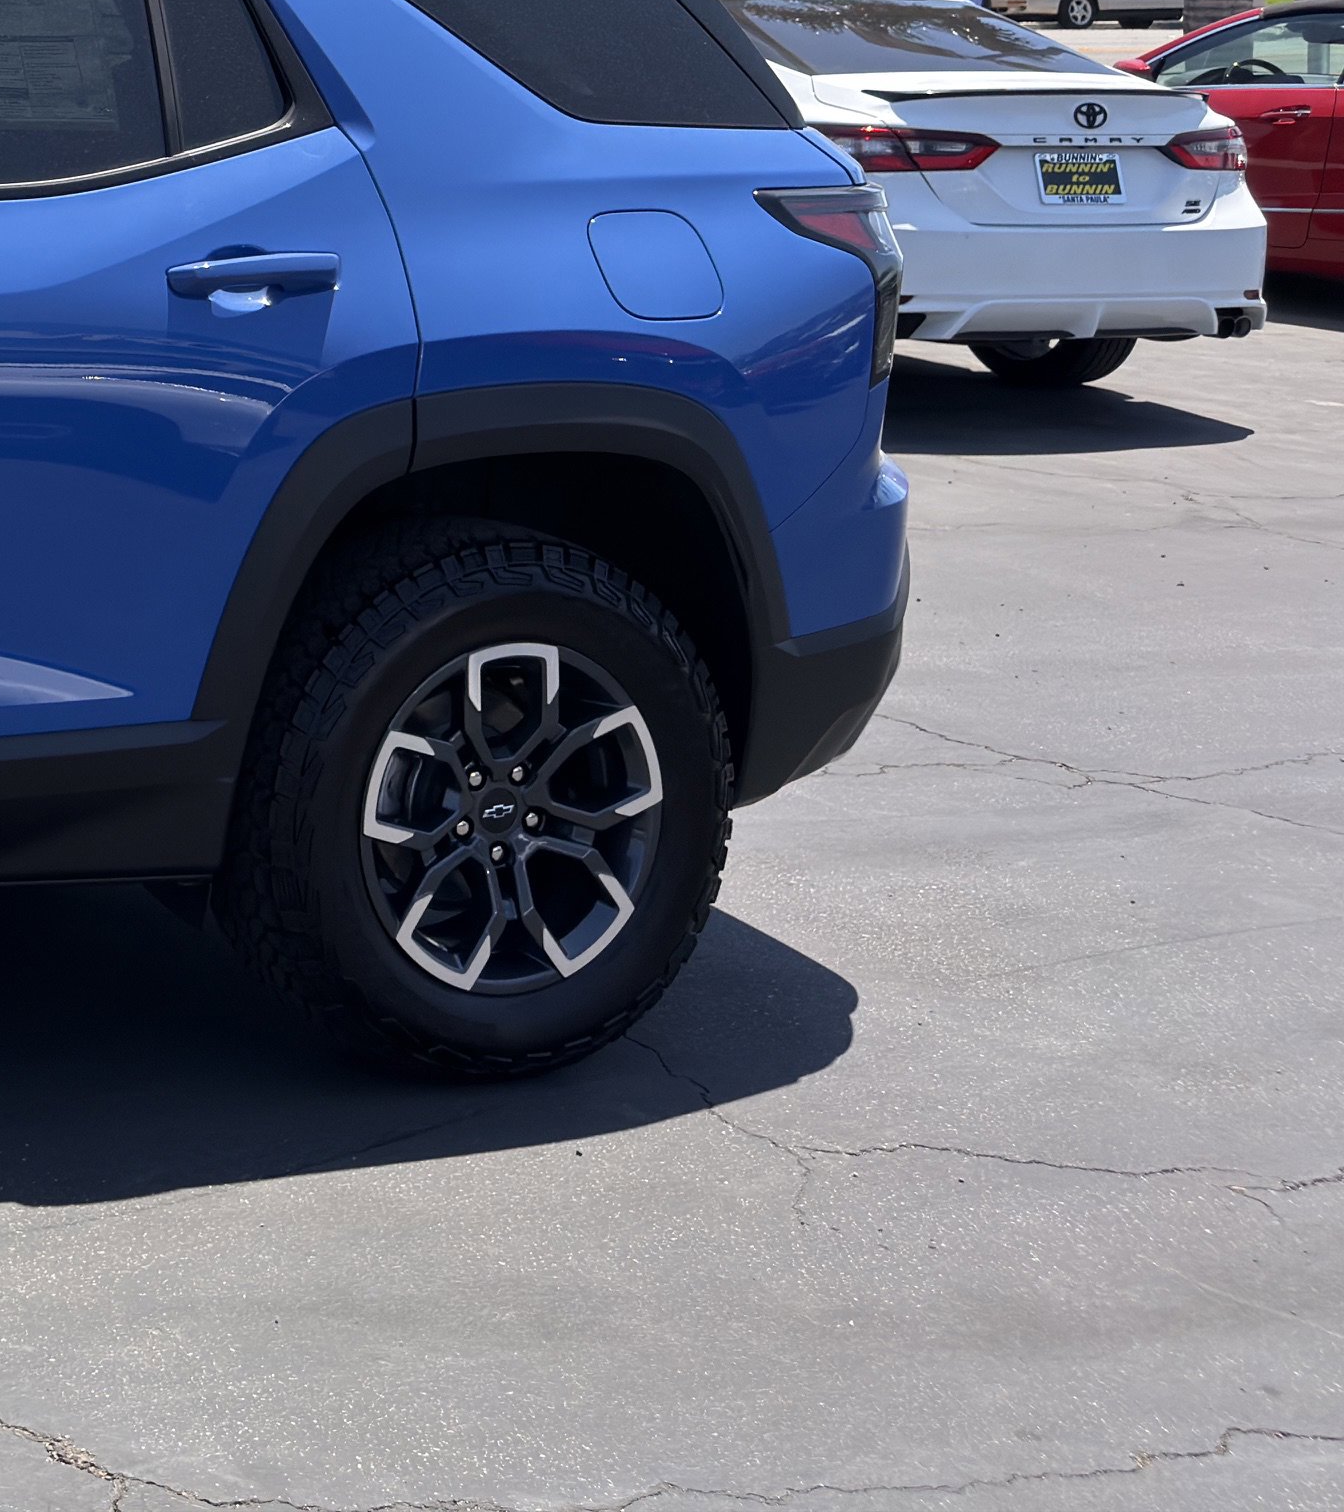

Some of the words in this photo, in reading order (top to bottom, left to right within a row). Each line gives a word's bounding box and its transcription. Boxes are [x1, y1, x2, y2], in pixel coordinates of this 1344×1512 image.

[1042, 163, 1114, 173] RUNNIN'
[1072, 174, 1089, 182] to
[1045, 184, 1115, 195] BUNNIN
